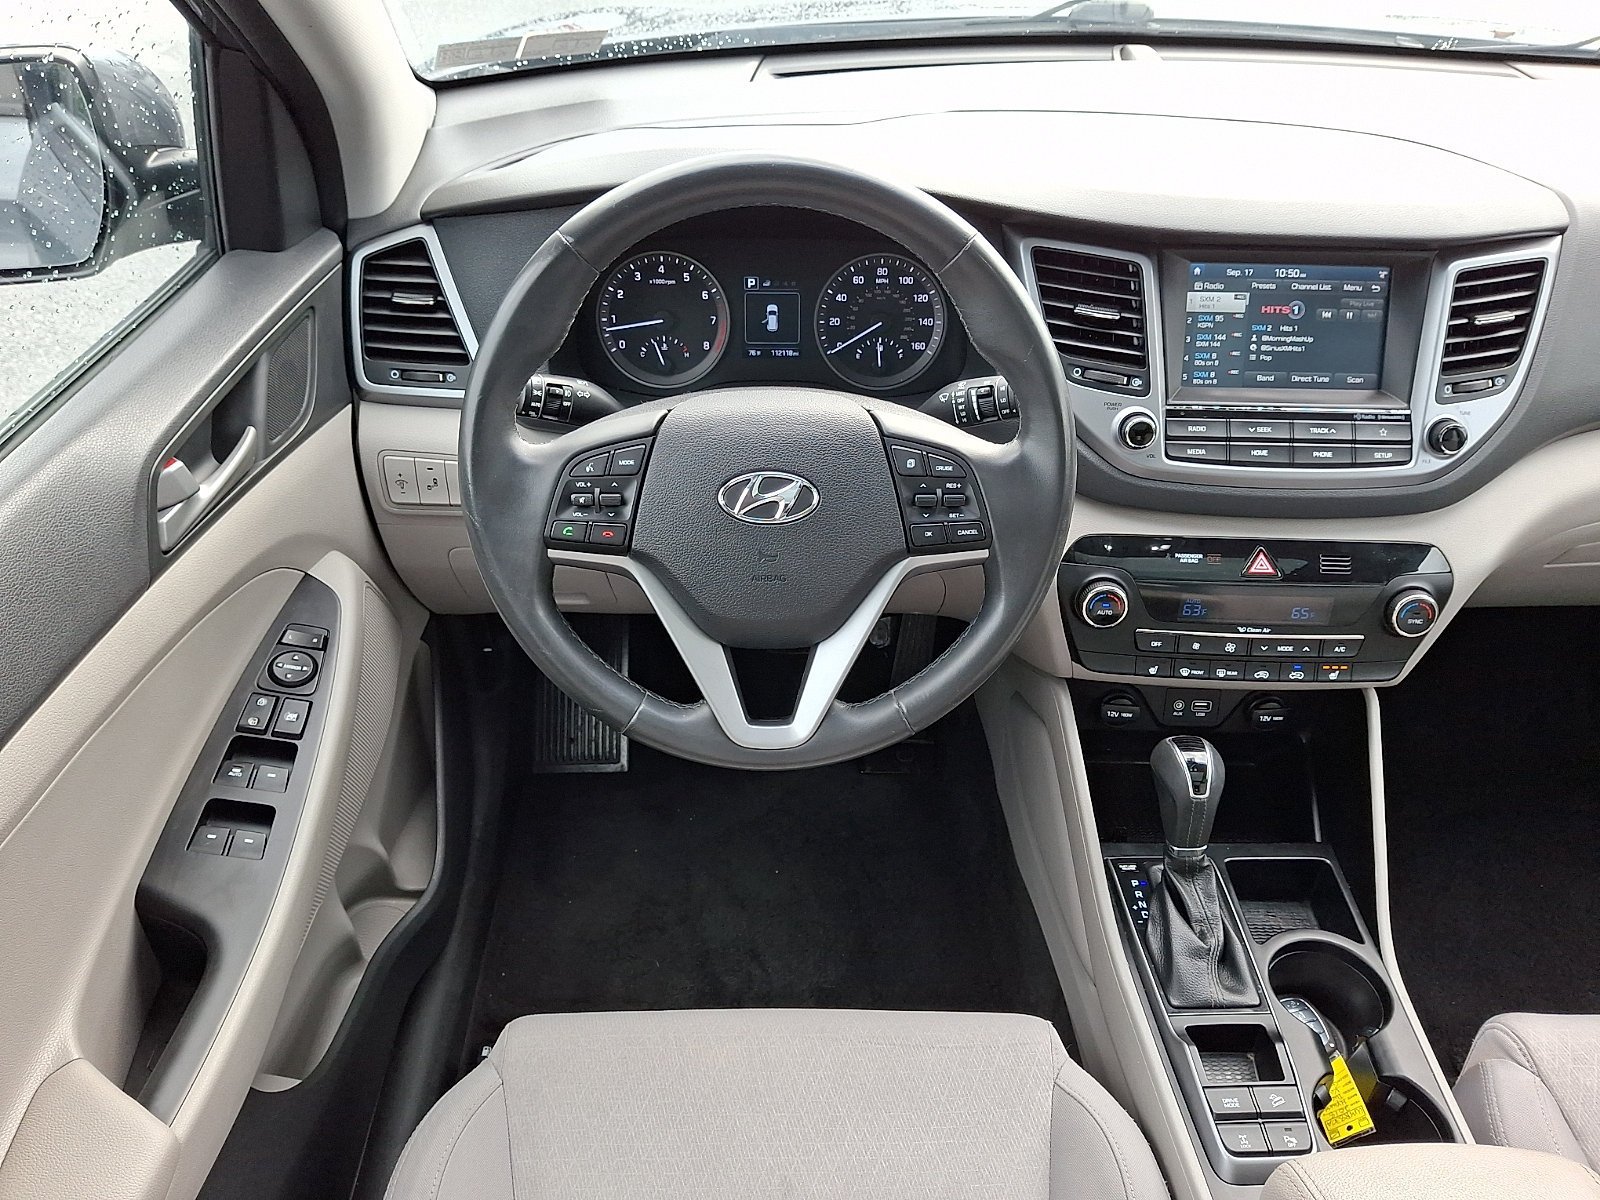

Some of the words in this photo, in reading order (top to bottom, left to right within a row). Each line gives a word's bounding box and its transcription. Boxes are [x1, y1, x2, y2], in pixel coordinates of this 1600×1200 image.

[658, 265, 664, 273] 4
[1226, 269, 1242, 277] Sep.
[634, 272, 641, 281] 3
[683, 273, 690, 281] 5
[853, 276, 864, 284] 60
[748, 279, 755, 288] P
[1204, 282, 1224, 290] Radio
[1251, 282, 1276, 290] Presets
[617, 290, 624, 298] 2
[702, 291, 708, 299] 6
[913, 294, 928, 302] 120
[1260, 305, 1290, 314] HITS
[611, 315, 616, 323] 1
[710, 316, 716, 325] 7
[829, 318, 840, 326] 20
[919, 318, 933, 326] 140
[619, 340, 626, 349] 0
[703, 342, 710, 350] 8
[911, 342, 925, 350] 160
[1260, 354, 1272, 362] Pop
